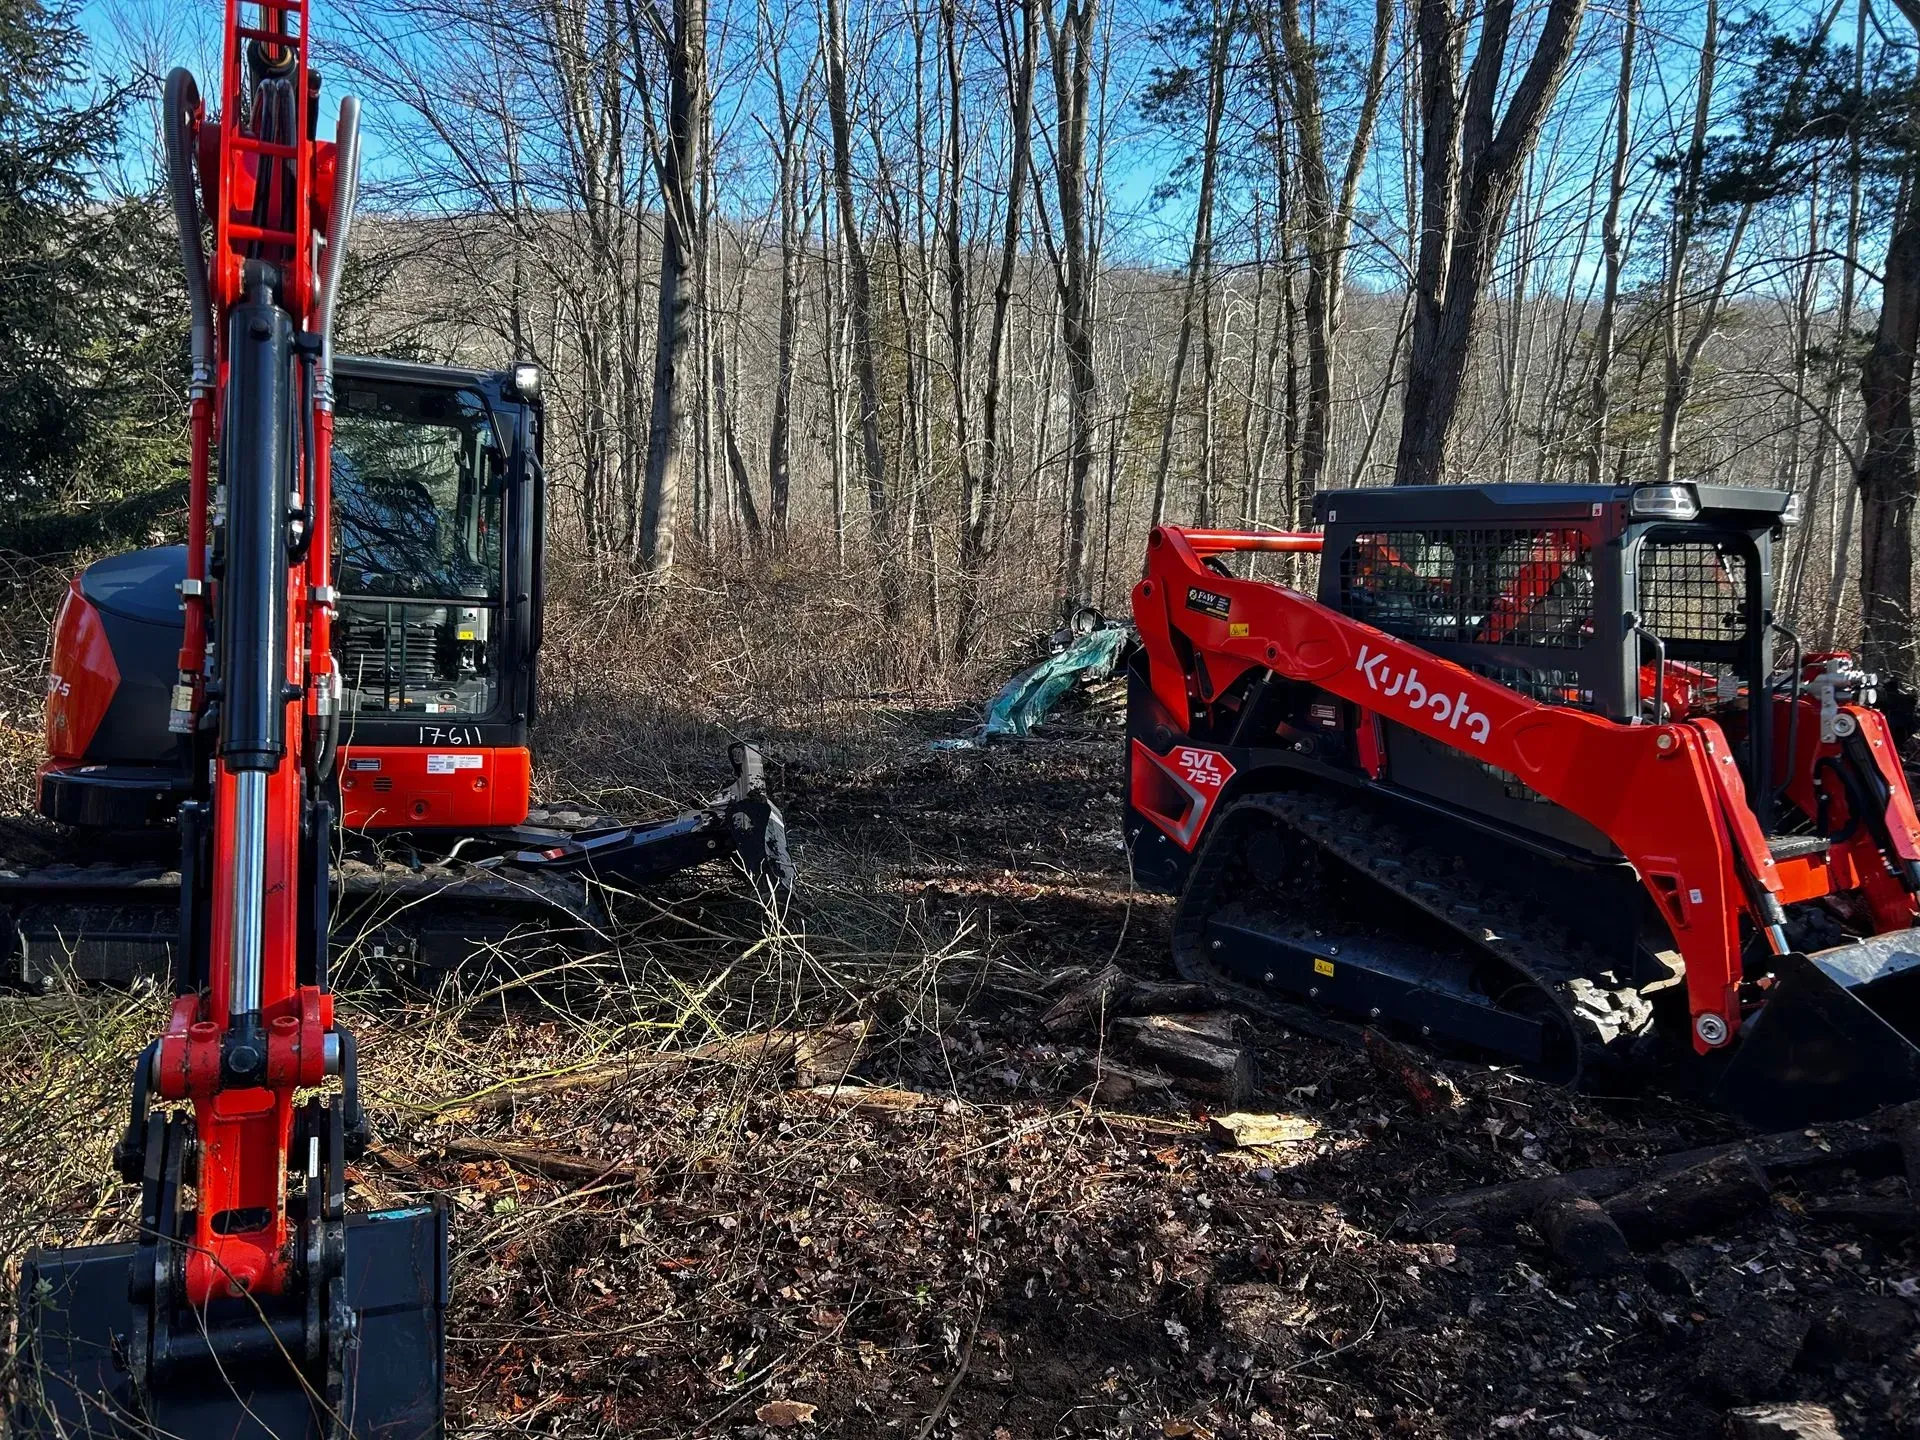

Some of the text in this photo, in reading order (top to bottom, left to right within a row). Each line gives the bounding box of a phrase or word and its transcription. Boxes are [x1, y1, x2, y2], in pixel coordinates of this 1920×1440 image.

[370, 482, 416, 498] Kubota
[1355, 645, 1490, 745] Kubota
[419, 726, 482, 745] 17611
[1178, 750, 1219, 772] SVL
[1186, 768, 1222, 786] 75-3
